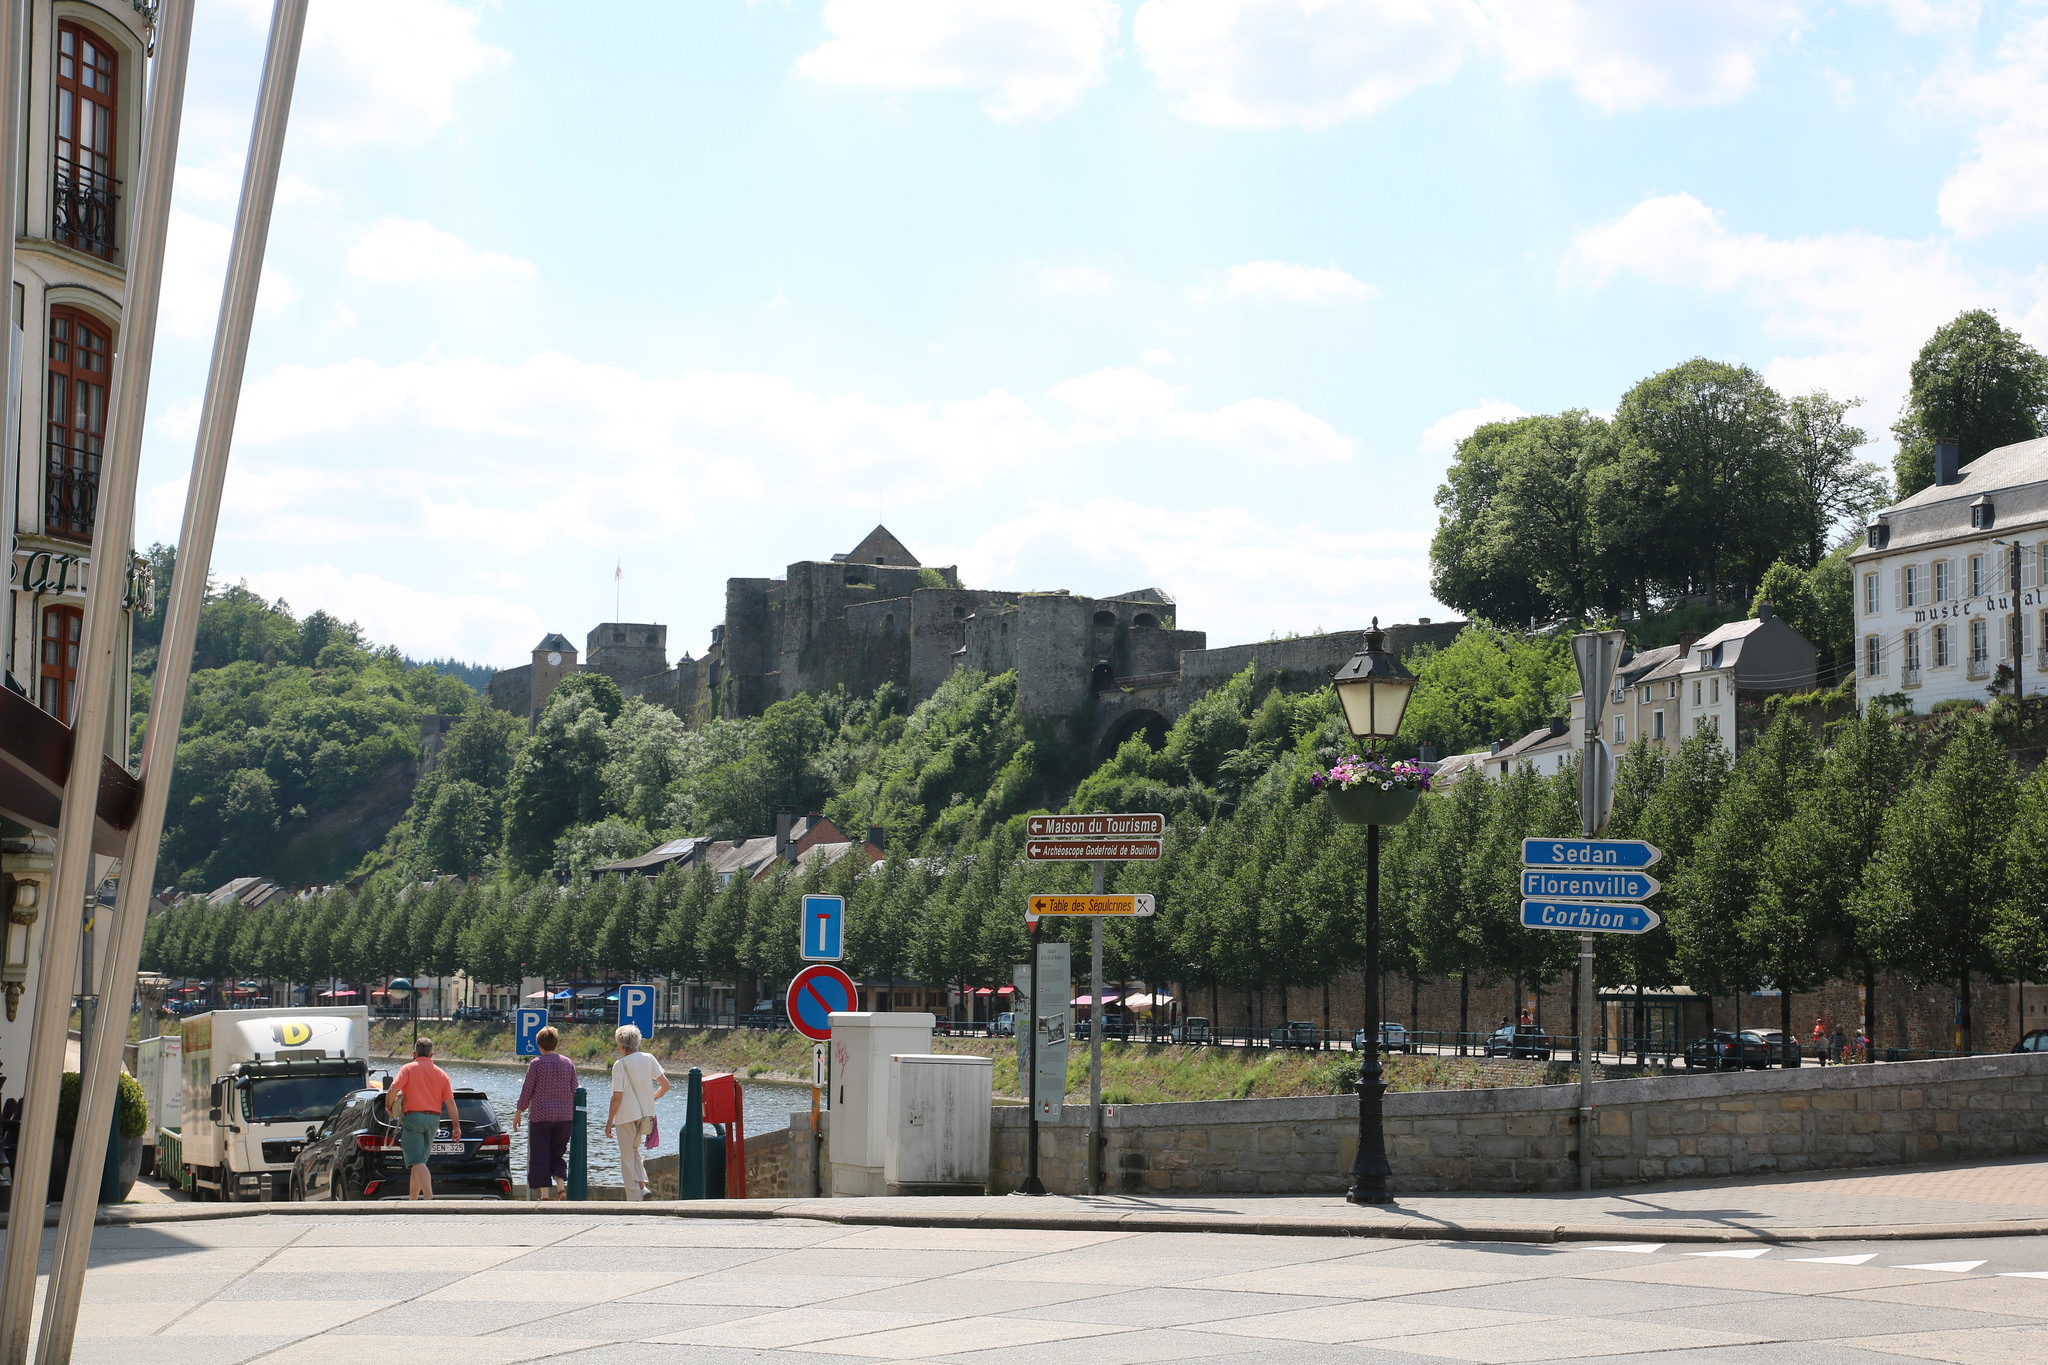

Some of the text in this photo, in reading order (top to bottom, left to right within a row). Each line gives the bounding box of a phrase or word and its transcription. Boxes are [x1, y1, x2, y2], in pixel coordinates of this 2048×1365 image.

[1914, 588, 2042, 623] musée dual
[1045, 817, 1158, 834] Maison du Tourisme
[1042, 844, 1157, 858] Archéoscope Godefroid de Bouillon
[1552, 843, 1617, 863] Sedan
[1528, 875, 1638, 895] Florenville
[1049, 898, 1132, 914] Table des Sépulcrines
[1541, 905, 1624, 927] Corbion
[626, 989, 647, 1017] P
[522, 1012, 540, 1037] P
